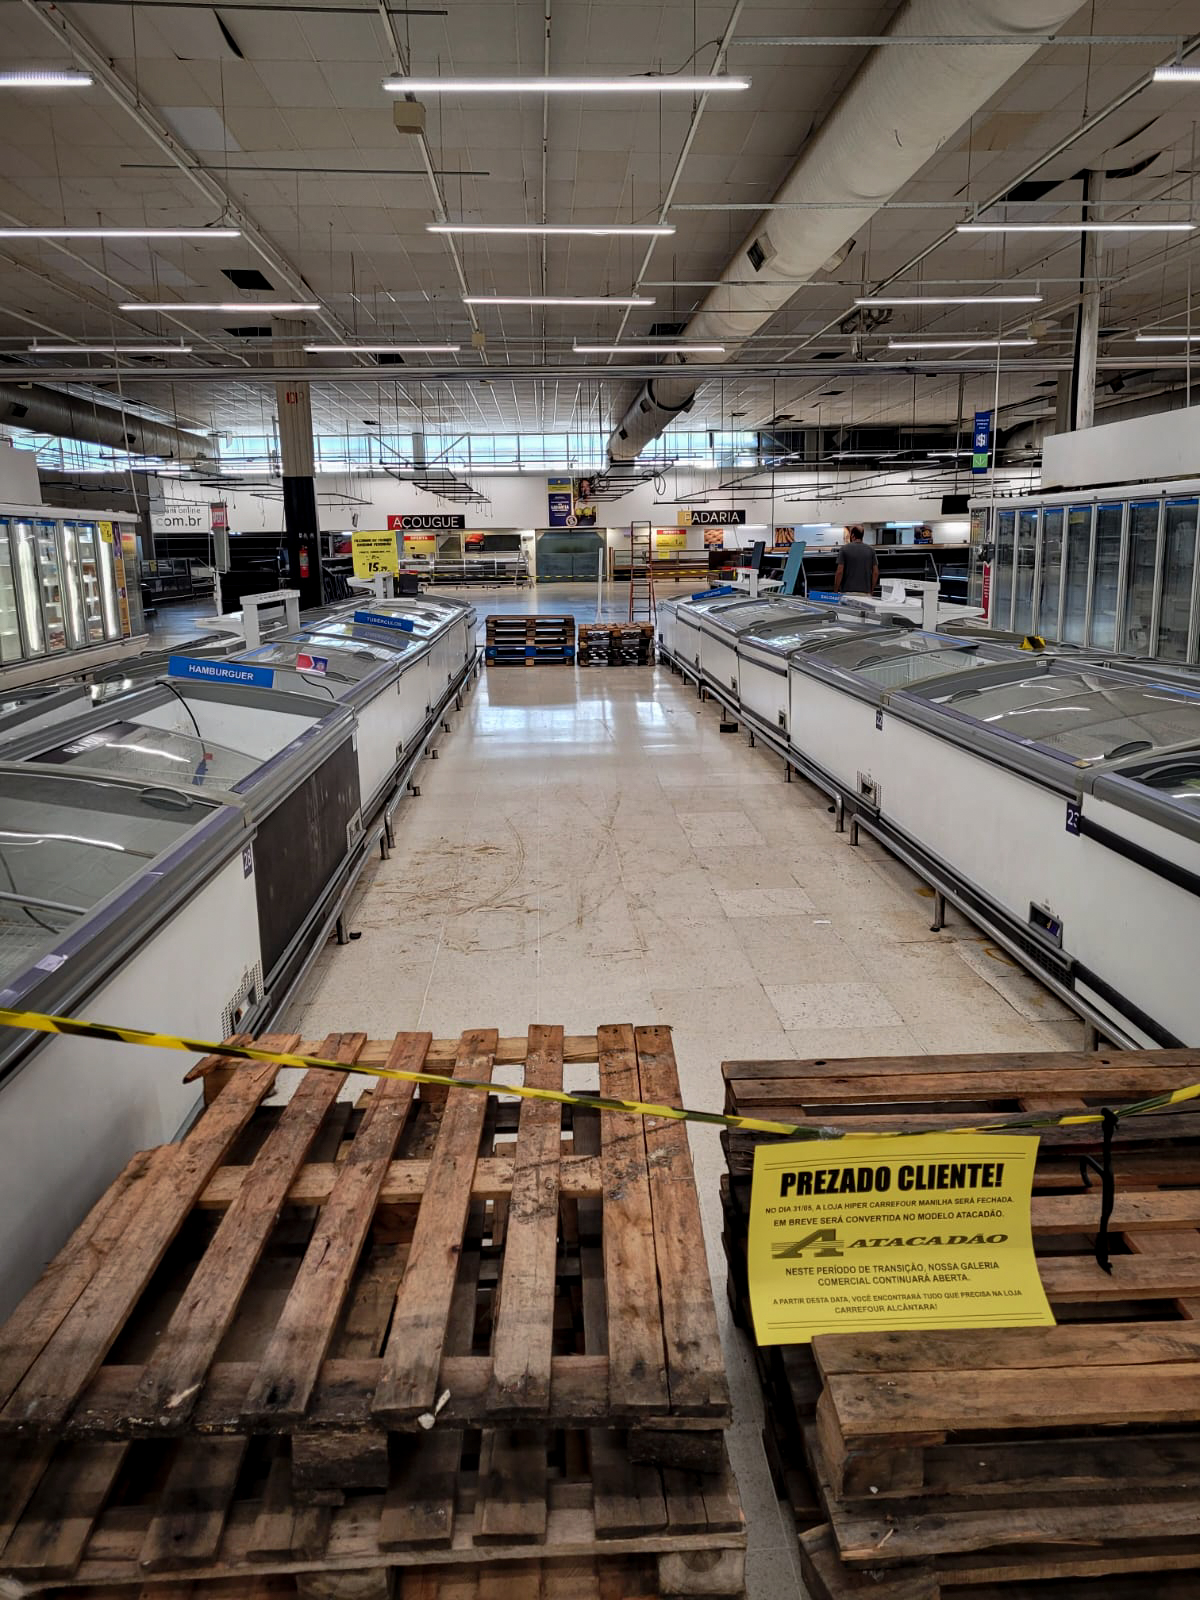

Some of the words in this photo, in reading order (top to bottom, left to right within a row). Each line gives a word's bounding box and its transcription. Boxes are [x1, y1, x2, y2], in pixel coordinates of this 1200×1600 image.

[393, 516, 460, 530] AÇOUGUE
[684, 511, 740, 523] PADARIA
[188, 664, 254, 681] HAMBURGUER
[243, 848, 252, 871] 28
[780, 1166, 891, 1198] PREZADO
[898, 1163, 1005, 1192] CLIENTE!
[779, 1205, 791, 1213] DIA
[823, 1202, 843, 1211] LOJA
[845, 1201, 868, 1209] HIPER
[869, 1199, 917, 1208] CARREFOUR
[919, 1198, 953, 1207] MANILHA
[955, 1195, 975, 1205] SERÁ
[977, 1195, 1015, 1204] FECHADA.
[774, 1219, 787, 1227] EM
[789, 1217, 818, 1226] BREVE
[820, 1214, 843, 1225] SERÁ
[845, 1213, 901, 1224] CONVERTIDA
[903, 1213, 916, 1222] NO
[917, 1211, 955, 1221] MODELO
[956, 1208, 1005, 1219] ATACADÃO.
[847, 1232, 1009, 1249] ATACADÃO
[785, 1266, 815, 1276] NESTE
[816, 1264, 857, 1275] PERÍODO
[858, 1265, 871, 1274] DE
[872, 1261, 926, 1274] TRANSIÇÃO,
[928, 1262, 959, 1272] NOSSA
[961, 1261, 1000, 1271] GALERIA
[817, 1277, 871, 1287] COMERCIAL
[872, 1273, 930, 1285] CONTINUARÁ
[932, 1273, 971, 1282] ABERTA.
[779, 1297, 805, 1305] PARTIR
[806, 1296, 829, 1304] DESTA
[830, 1295, 851, 1303] DATA,
[851, 1293, 872, 1302] VOCÊ
[873, 1292, 921, 1302] ENCONTRARÁ
[923, 1292, 942, 1300] TUDO
[960, 1290, 991, 1298] PRECISA
[1003, 1289, 1023, 1297] LOJA
[834, 1305, 886, 1315] CARREFOUR
[887, 1302, 938, 1313] ALCÂNTARA!
